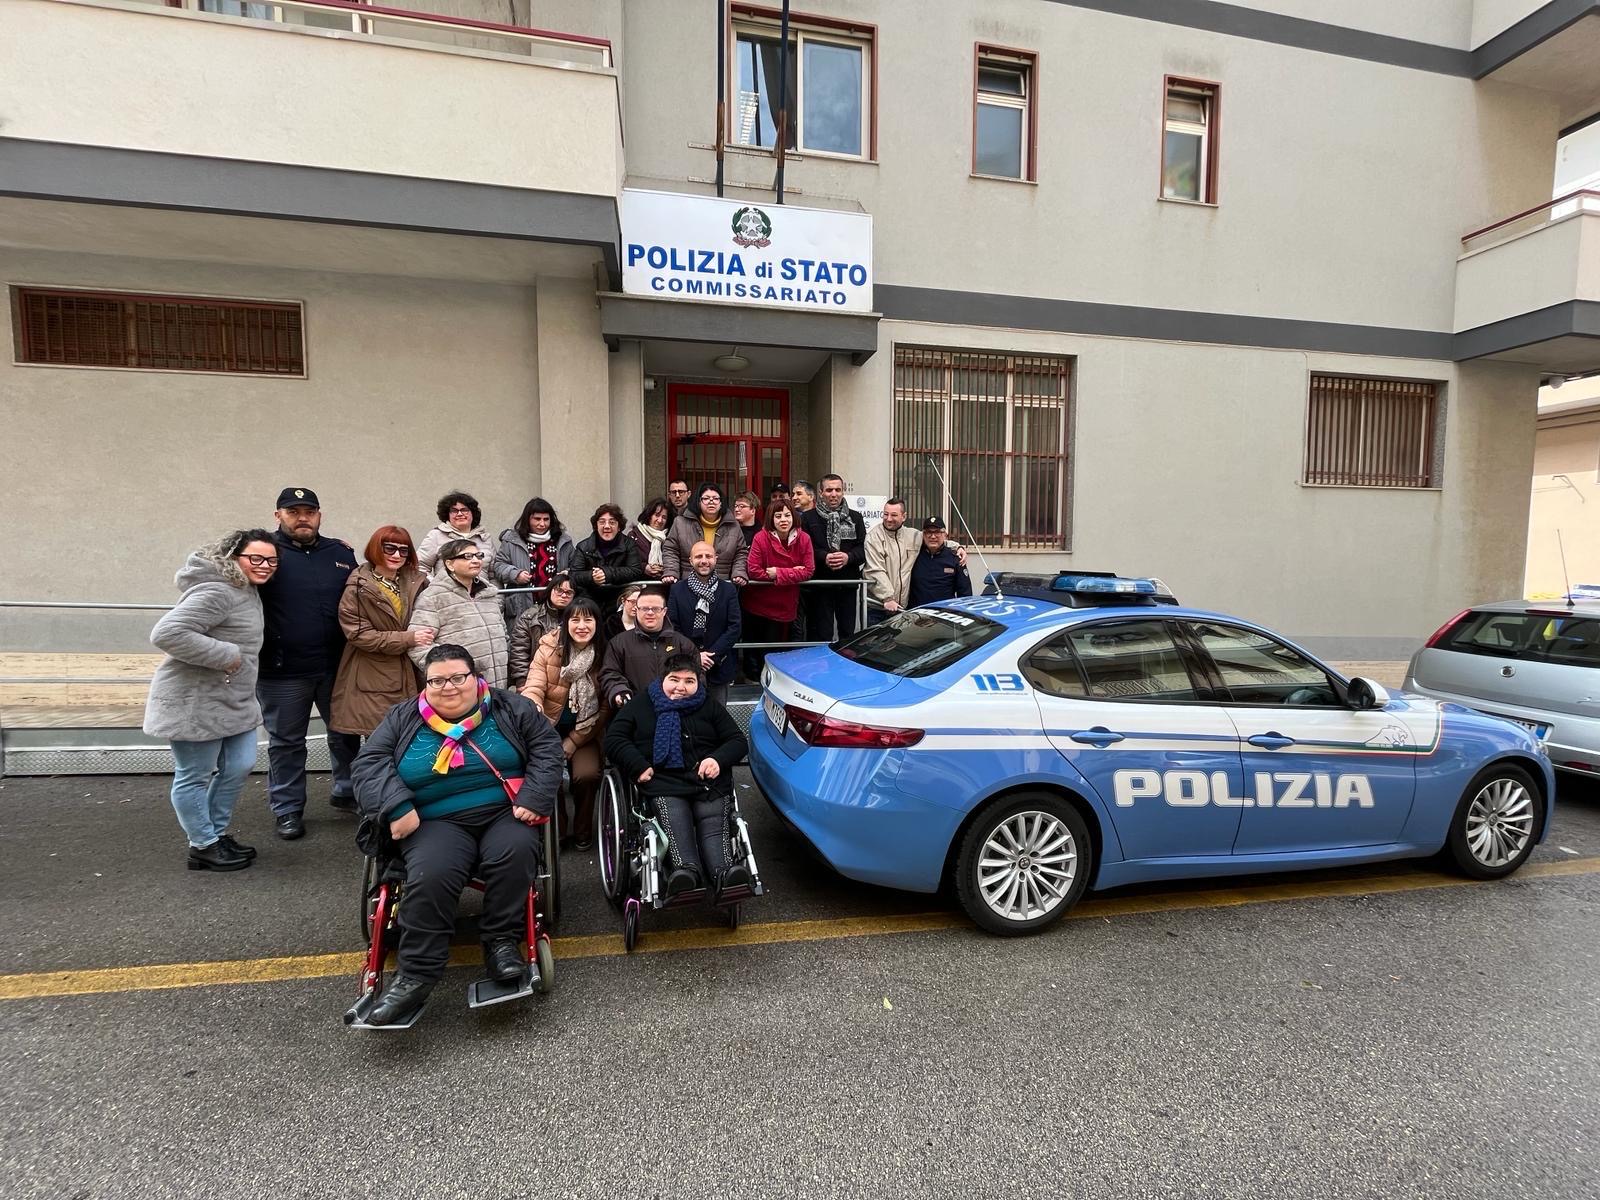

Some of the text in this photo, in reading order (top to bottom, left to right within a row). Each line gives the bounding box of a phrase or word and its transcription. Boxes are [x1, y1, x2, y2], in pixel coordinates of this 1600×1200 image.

[628, 244, 868, 287] POLIZIA di STATO
[651, 277, 847, 305] COMMISSARIATO
[861, 510, 884, 518] ARIATO
[970, 673, 1025, 691] 113
[1113, 768, 1375, 809] POLIZIA
